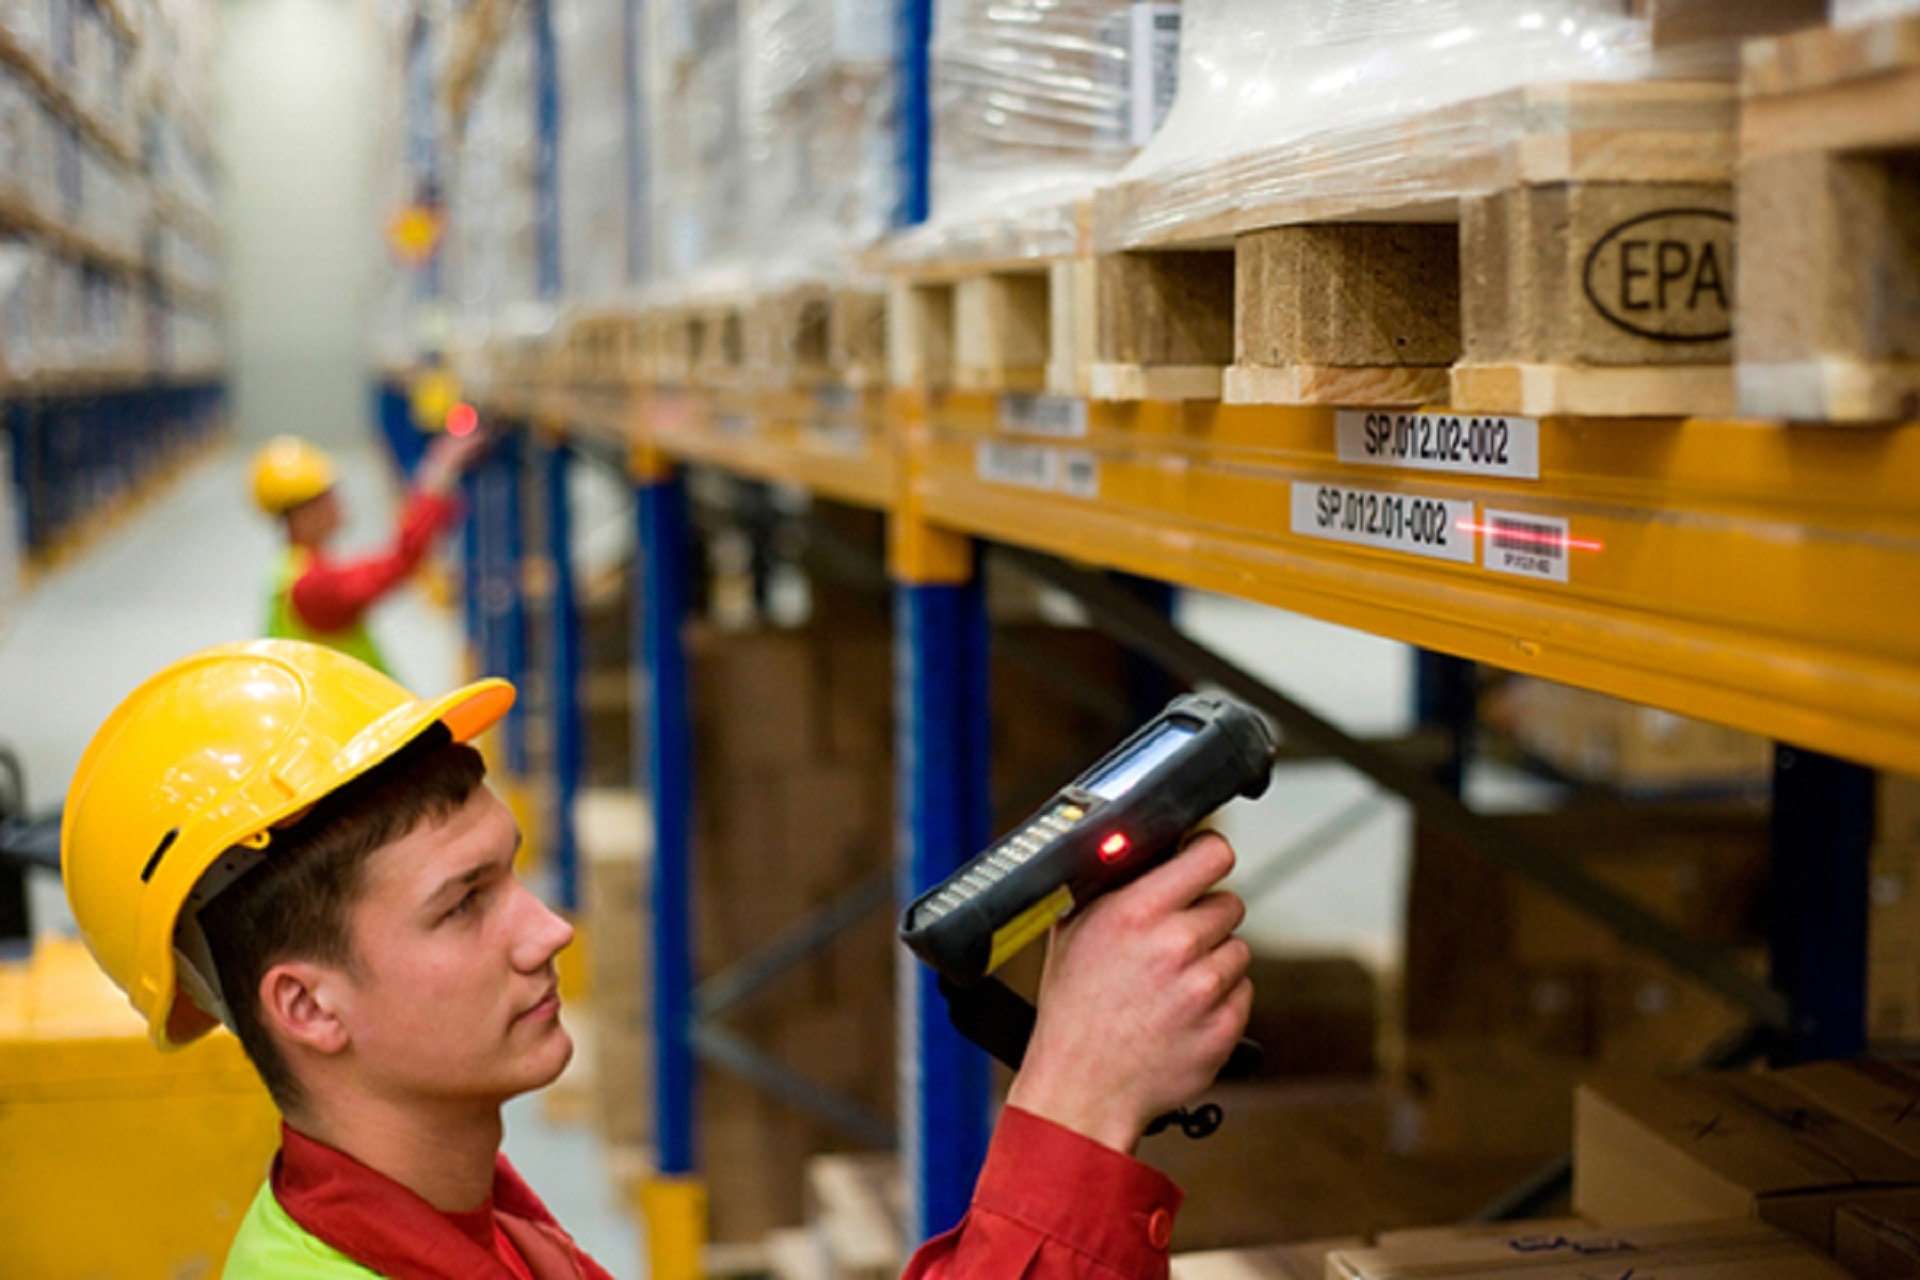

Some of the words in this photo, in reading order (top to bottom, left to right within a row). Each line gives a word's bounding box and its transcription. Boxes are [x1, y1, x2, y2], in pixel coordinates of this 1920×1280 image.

[1620, 240, 1731, 311] EPA
[1364, 413, 1509, 464] SP.012.02-002
[1316, 487, 1447, 545] SP.012.01-002
